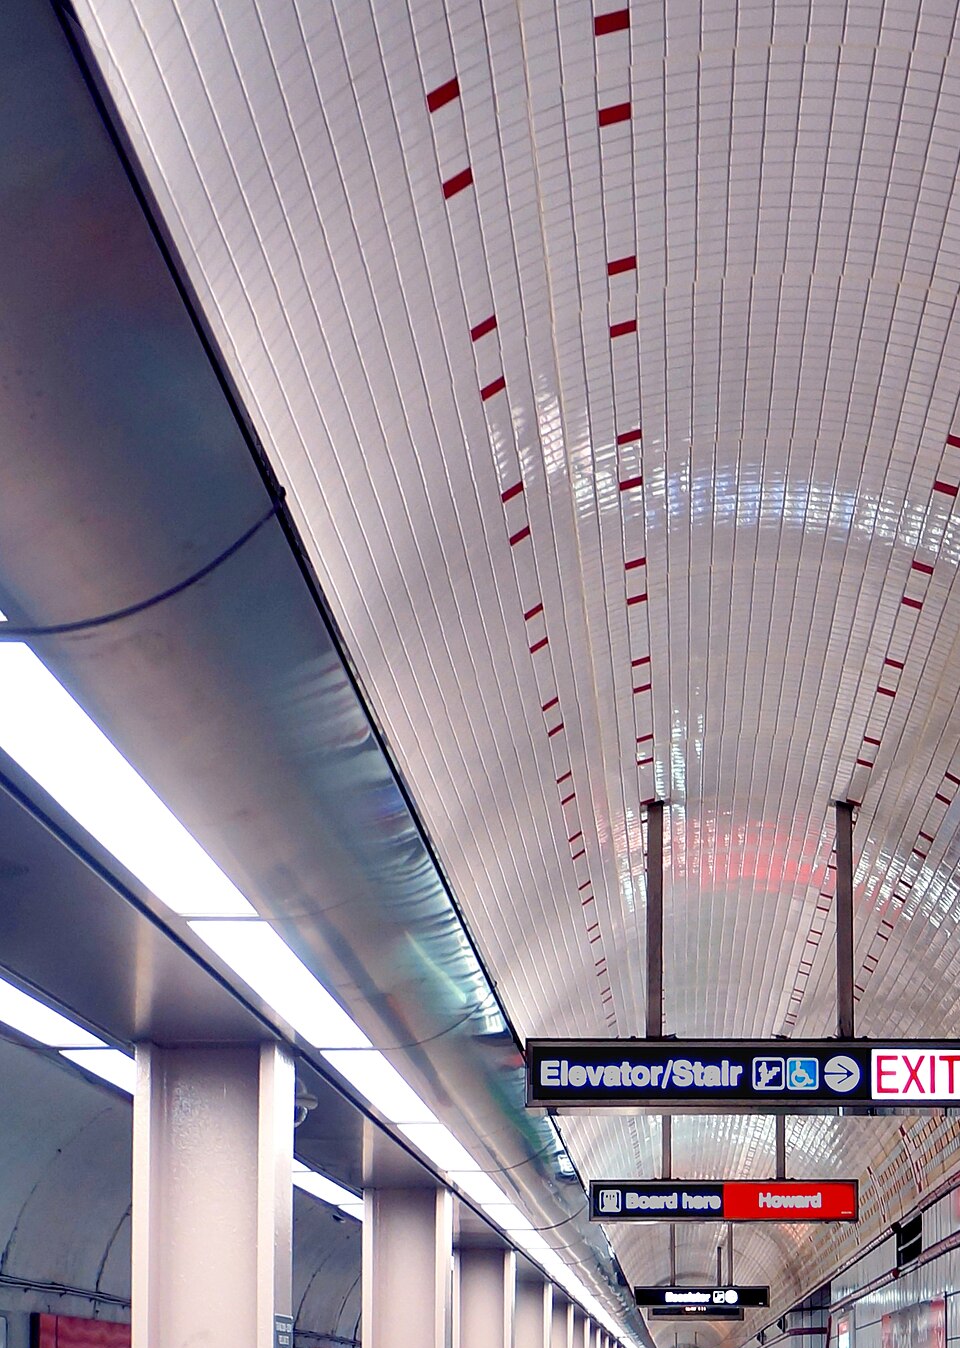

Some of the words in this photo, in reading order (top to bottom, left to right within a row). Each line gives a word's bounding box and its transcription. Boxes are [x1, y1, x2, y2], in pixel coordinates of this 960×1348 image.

[539, 1059, 743, 1089] Elevator/Stair
[626, 1191, 678, 1210] Board
[682, 1192, 721, 1210] here
[758, 1192, 823, 1209] Howard
